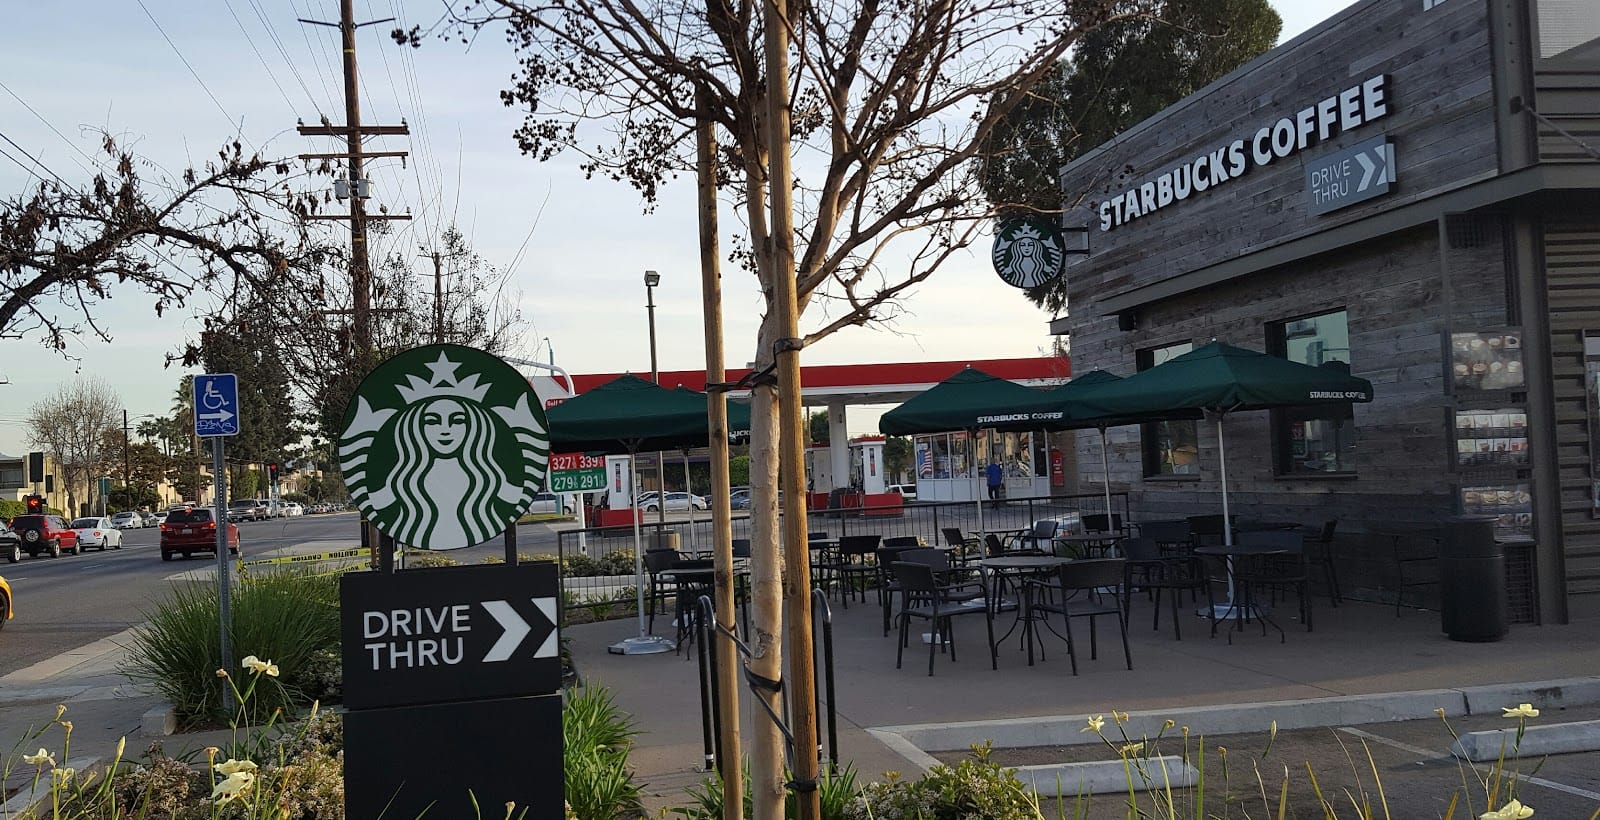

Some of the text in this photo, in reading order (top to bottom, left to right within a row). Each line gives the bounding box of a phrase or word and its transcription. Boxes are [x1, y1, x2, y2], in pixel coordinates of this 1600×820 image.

[1099, 74, 1388, 232] STARBUCKS COFFEE
[1311, 159, 1351, 188] DRIVE
[1312, 179, 1349, 206] THRU
[1310, 391, 1344, 399] STARBUCKS
[977, 413, 1029, 423] STARBUCKS
[552, 456, 572, 470] 327
[554, 476, 574, 490] 279
[581, 475, 599, 488] 291
[291, 554, 322, 562] CAUTION
[328, 550, 358, 559] CAUTION
[363, 604, 472, 639] DRIVE
[364, 637, 465, 671] THRU
